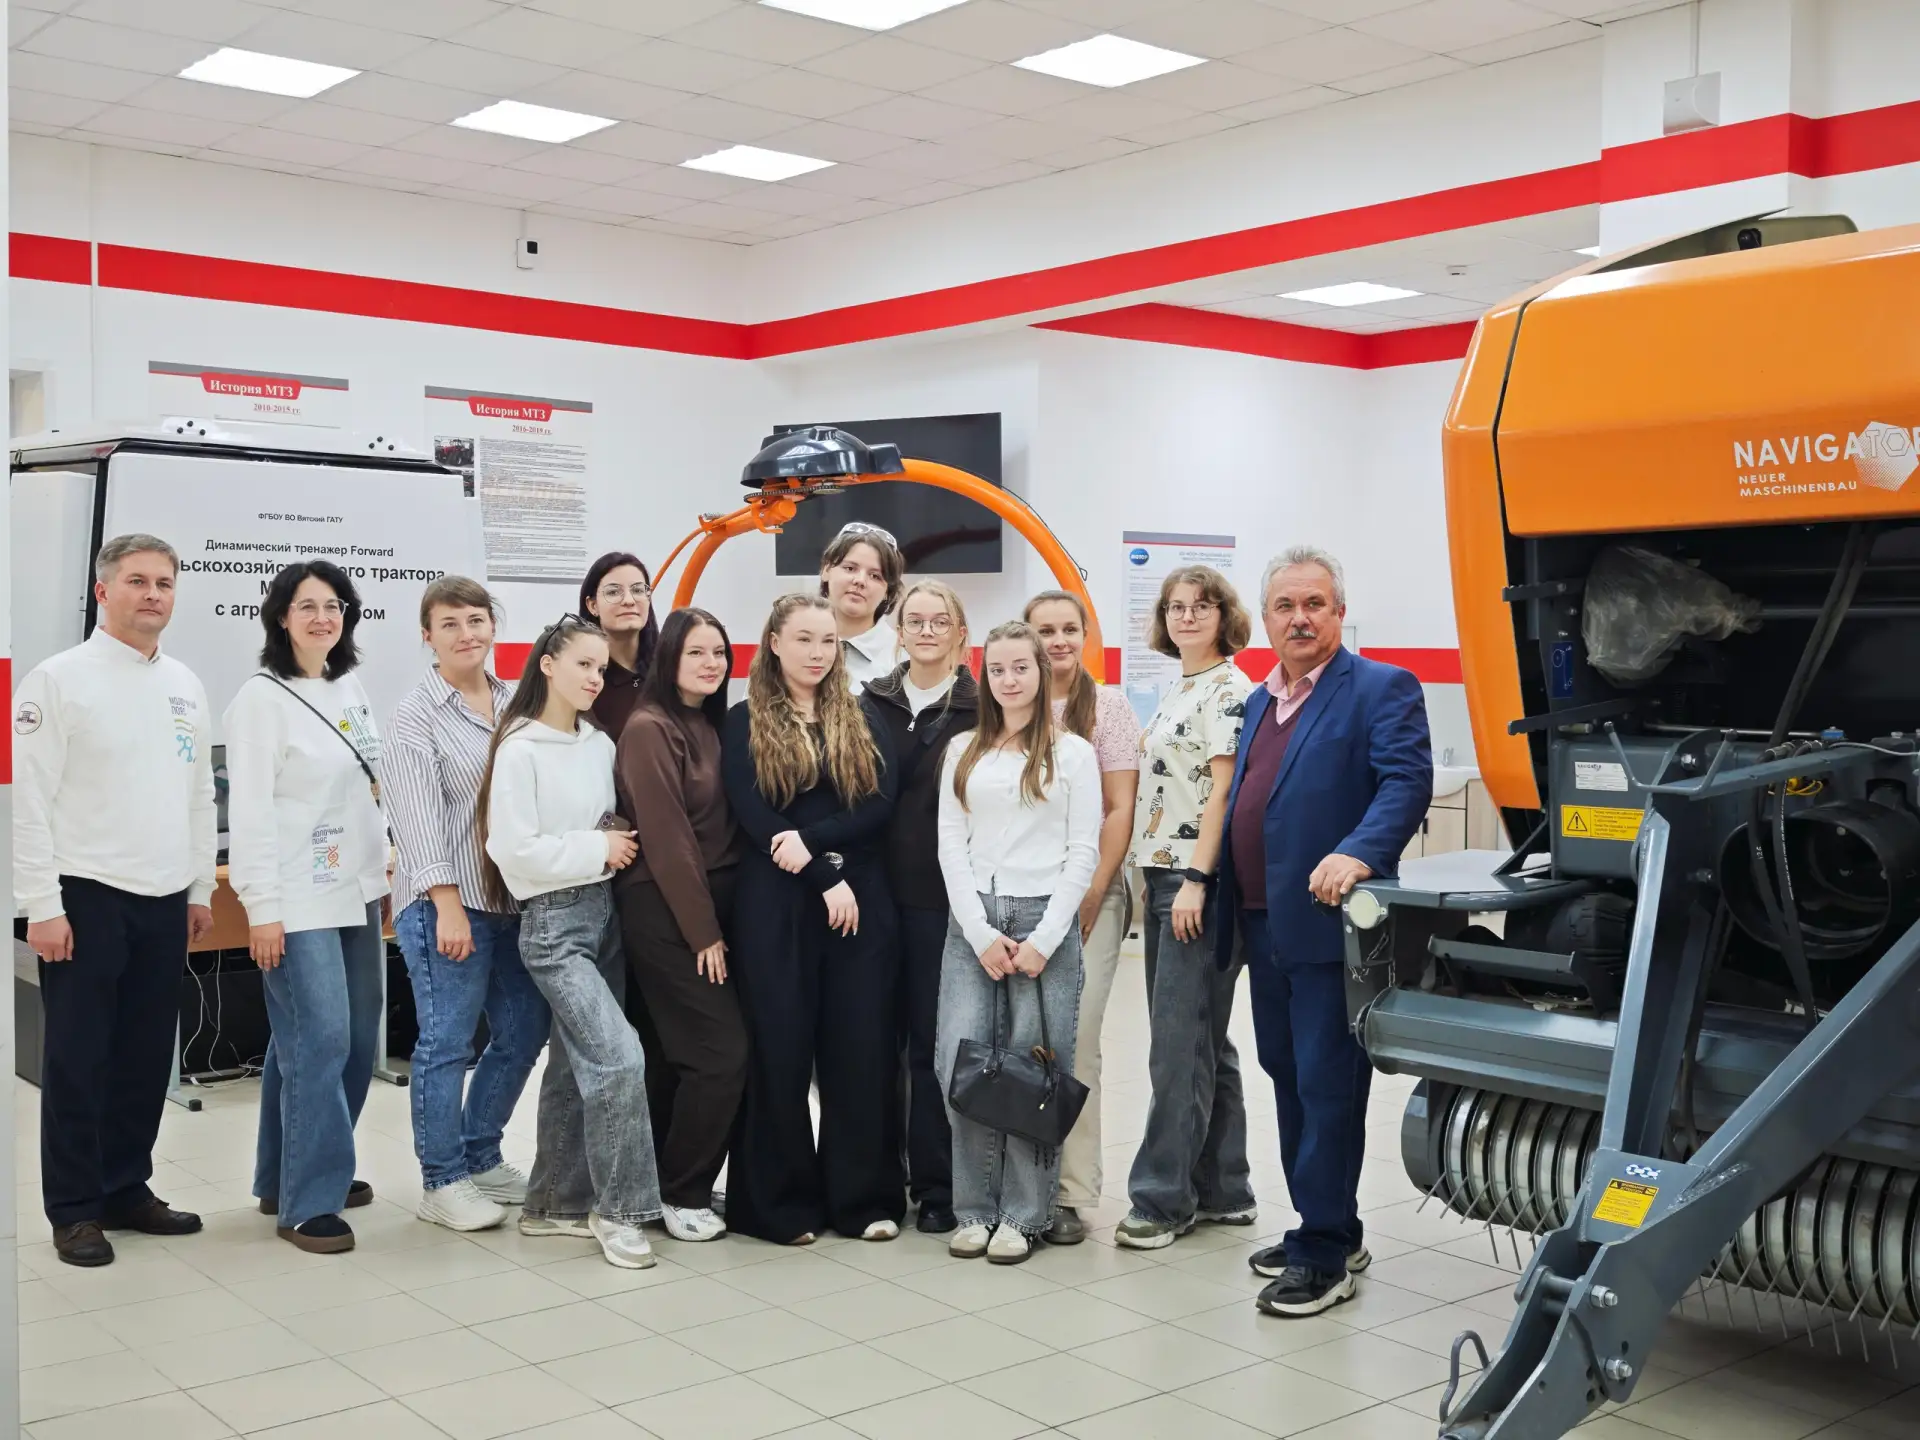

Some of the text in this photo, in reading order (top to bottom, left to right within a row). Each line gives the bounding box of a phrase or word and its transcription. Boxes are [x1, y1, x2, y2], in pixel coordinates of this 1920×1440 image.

[210, 380, 294, 397] История МТЗ
[253, 404, 290, 413] 2010-2015
[476, 404, 546, 419] История МТЗ
[512, 425, 543, 434] 2016-2019
[1739, 472, 1786, 485] NEUER
[1740, 481, 1857, 497] MASCHINENBAU
[258, 513, 283, 521] ФГБОУ
[205, 540, 394, 557] Динамический тренажер Forward
[371, 566, 445, 583] трактора
